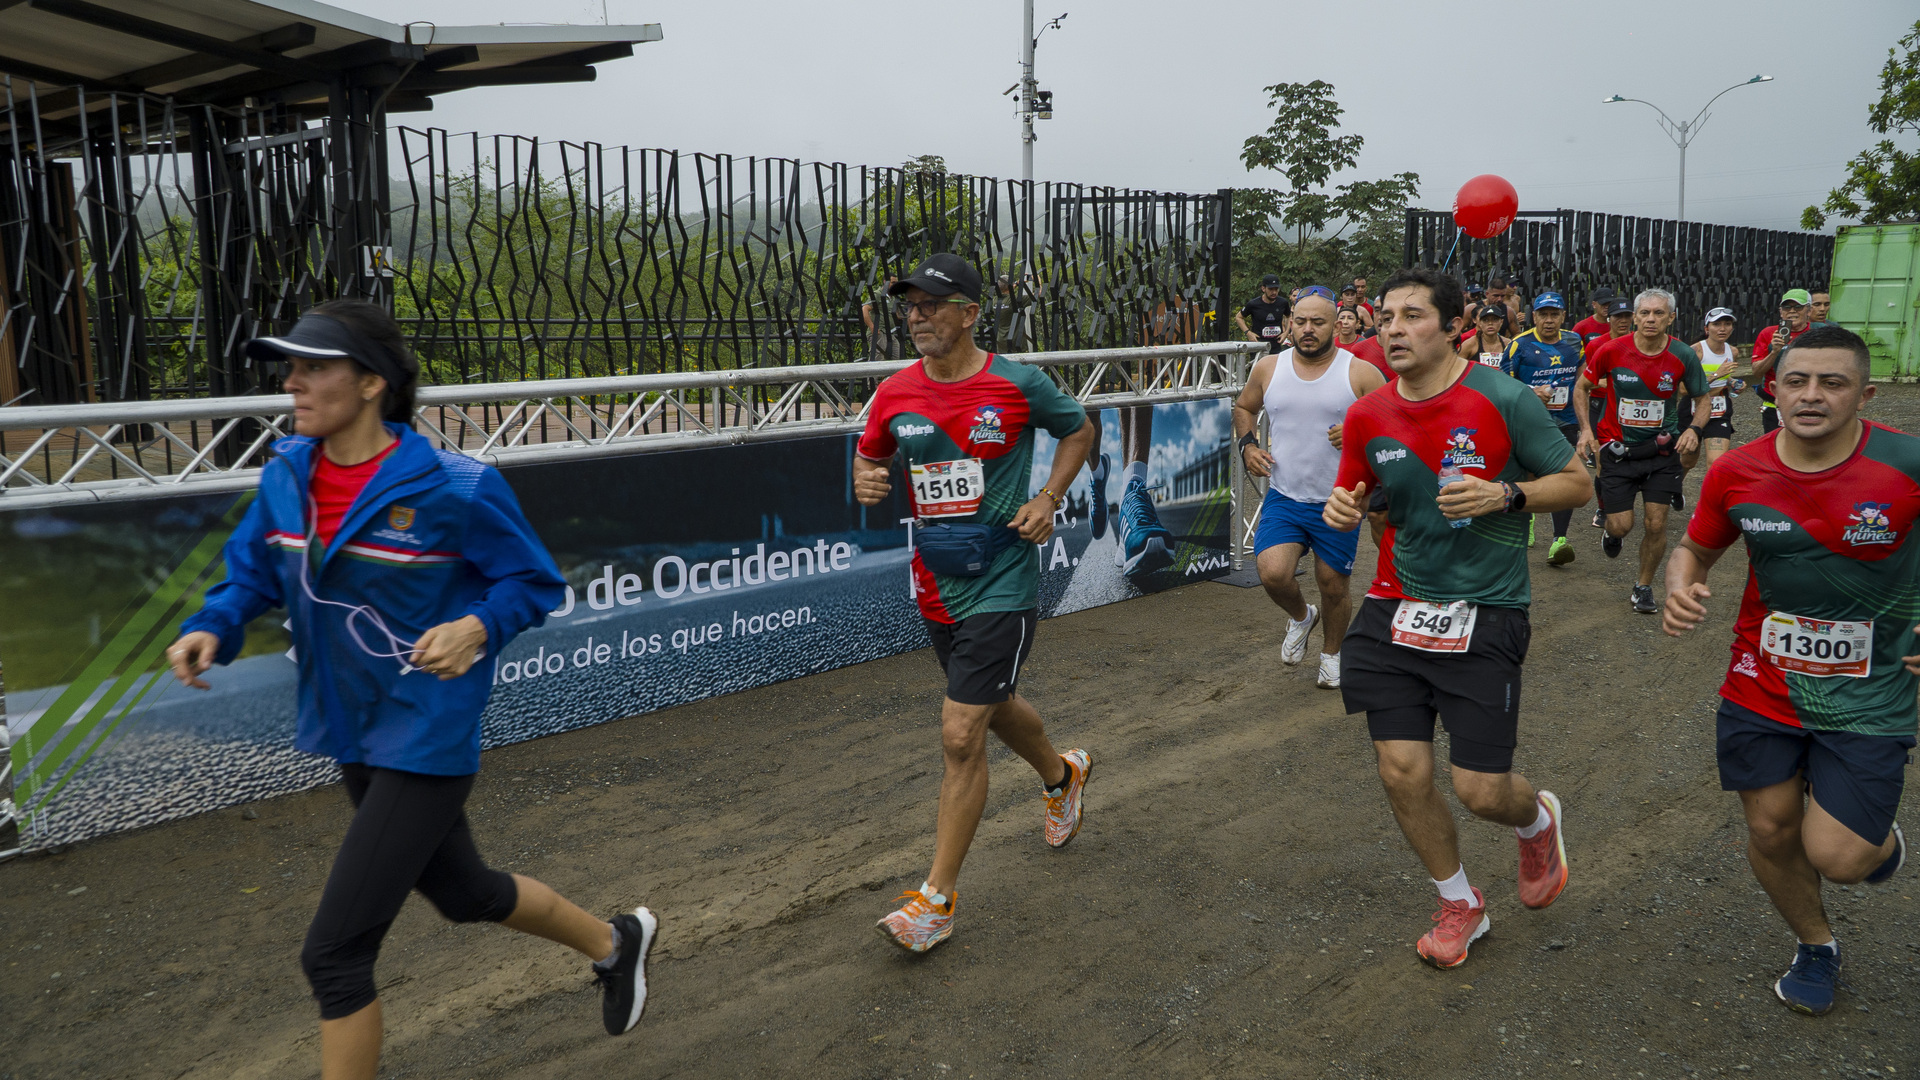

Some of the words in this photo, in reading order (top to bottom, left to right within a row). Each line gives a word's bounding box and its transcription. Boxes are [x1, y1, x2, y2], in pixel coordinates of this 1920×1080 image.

[1532, 366, 1577, 377] ACERTEMOS
[1633, 408, 1649, 419] 30
[968, 429, 1006, 442] Muñeca
[917, 477, 970, 500] 1518
[1842, 529, 1898, 544] Muñeca
[1859, 525, 1871, 533] La
[1184, 554, 1230, 577] AVAL
[1190, 551, 1209, 561] Grupo
[587, 565, 642, 610] de
[653, 538, 851, 600] Occidente
[1410, 610, 1452, 635] 549
[493, 647, 565, 686] lado
[573, 637, 612, 668] de
[621, 630, 662, 660] los
[671, 619, 723, 655] que
[731, 605, 817, 638] hacen.
[1779, 632, 1852, 660] 1300
